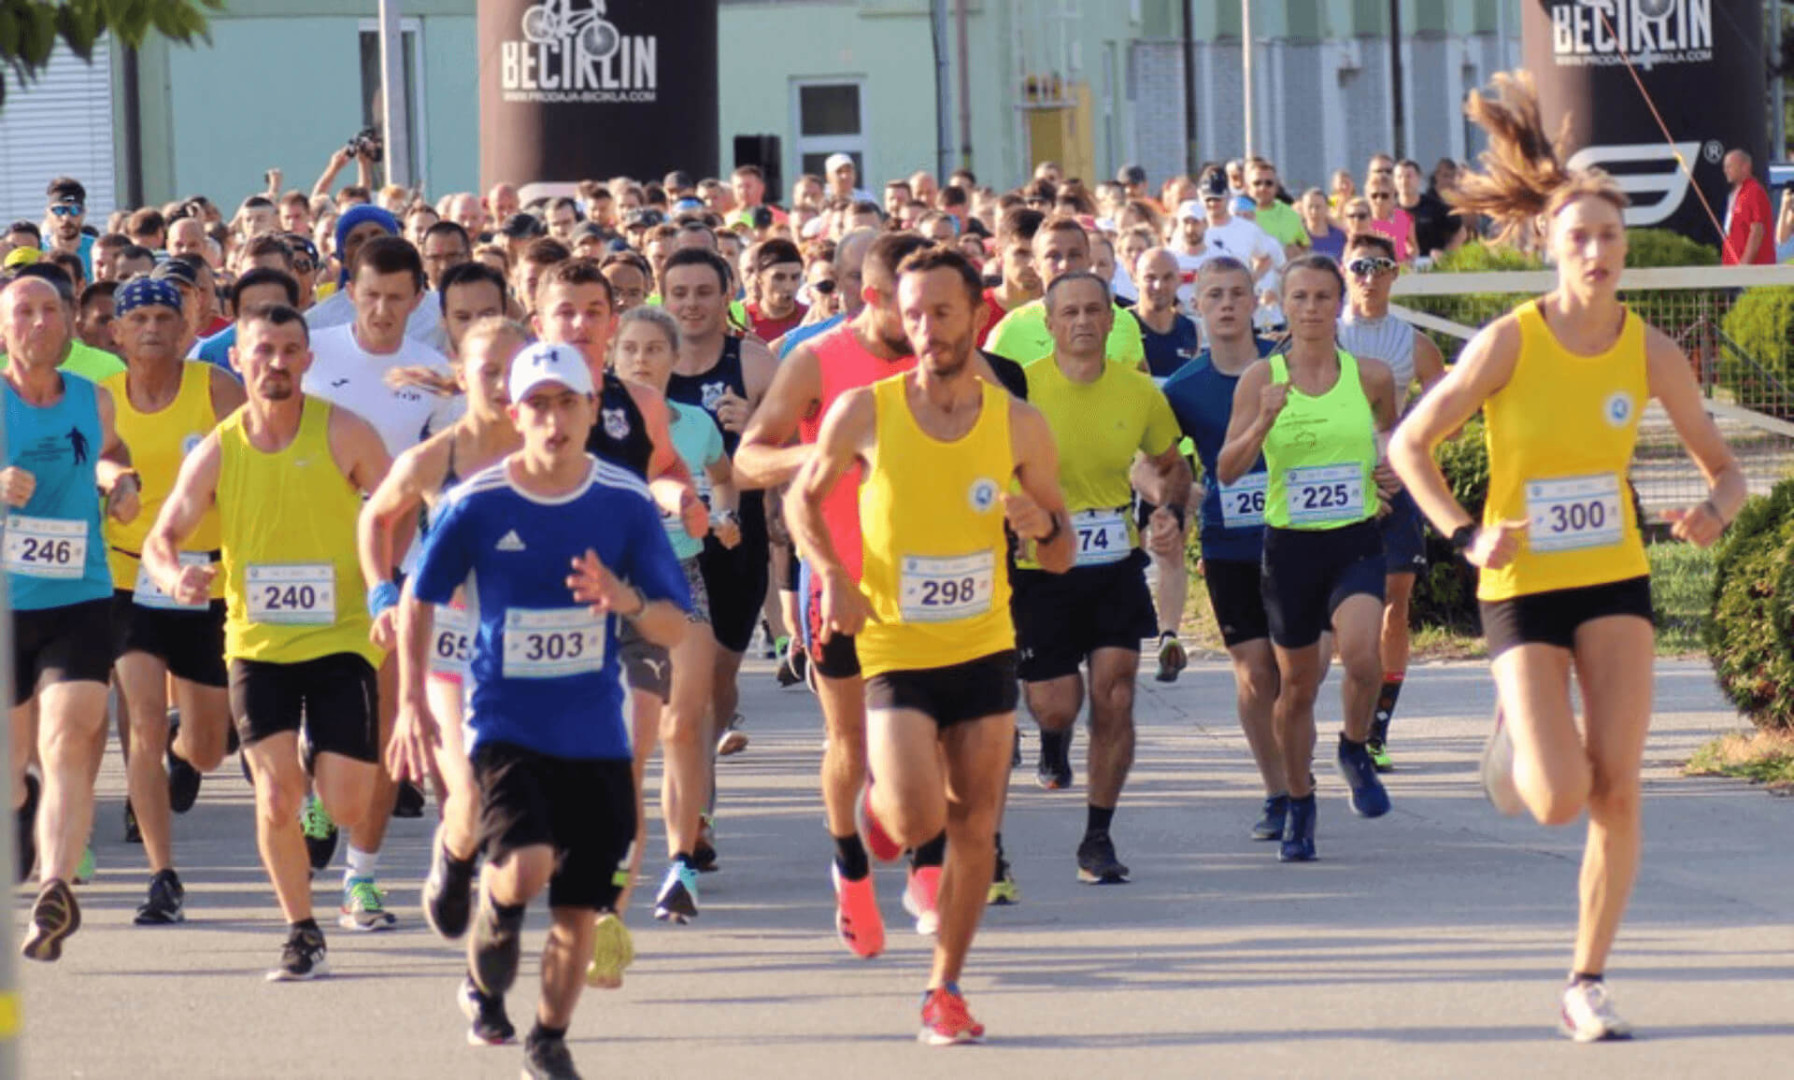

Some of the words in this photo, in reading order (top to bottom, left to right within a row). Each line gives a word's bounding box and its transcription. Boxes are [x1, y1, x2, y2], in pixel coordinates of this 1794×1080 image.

[1303, 484, 1349, 509] 225
[1551, 501, 1605, 532] 300
[21, 537, 71, 563] 246
[265, 585, 315, 610] 240
[921, 577, 975, 606] 298
[526, 632, 584, 660] 303
